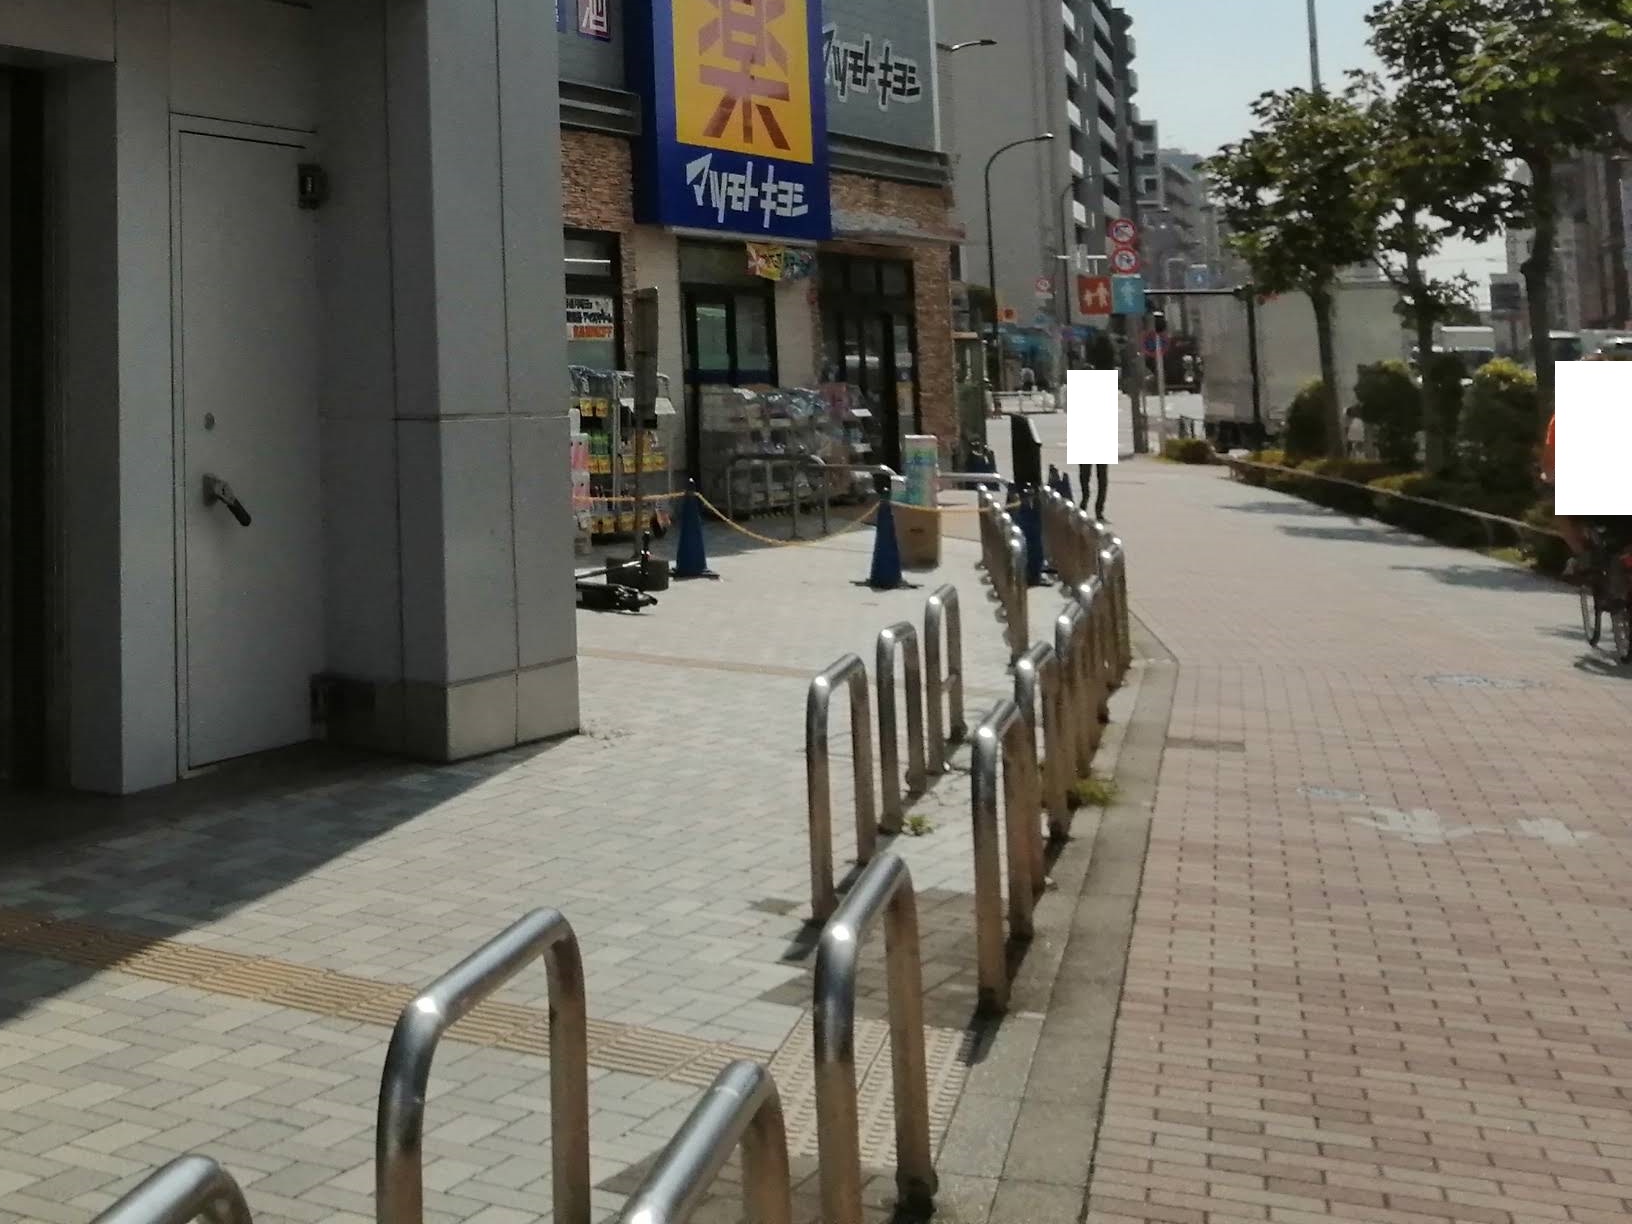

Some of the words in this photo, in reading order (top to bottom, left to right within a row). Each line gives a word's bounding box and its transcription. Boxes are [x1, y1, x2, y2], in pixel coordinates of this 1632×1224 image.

[685, 152, 809, 229] マツモトキヨシ
